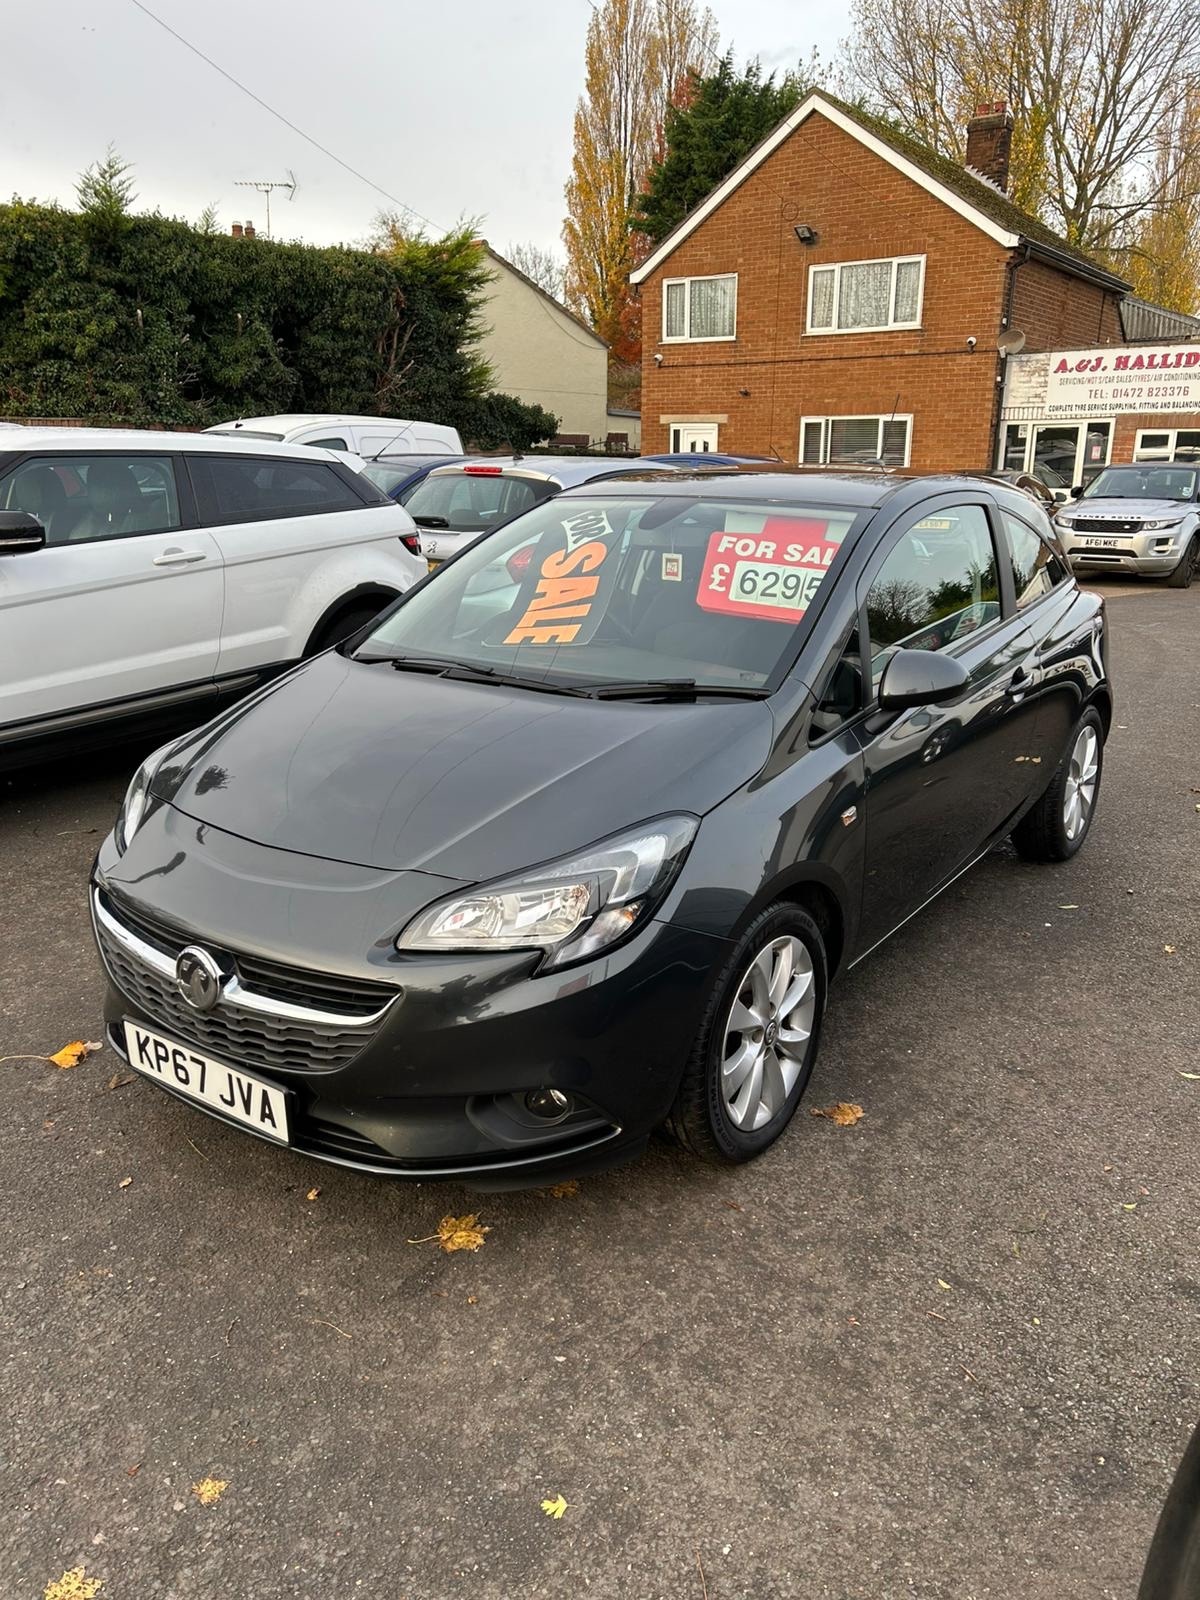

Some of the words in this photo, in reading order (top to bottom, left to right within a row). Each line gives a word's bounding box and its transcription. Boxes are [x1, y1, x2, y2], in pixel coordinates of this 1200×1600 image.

[1113, 352, 1200, 370] HALLID
[1048, 404, 1073, 412] COMPLETE
[1088, 403, 1108, 411] SERVICE
[1139, 401, 1159, 410] FITTING
[1160, 401, 1171, 409] AND
[1089, 389, 1108, 399] TEL:
[1112, 387, 1143, 399] 01472
[1147, 386, 1190, 397] 823376
[566, 510, 606, 544] FOR
[717, 535, 777, 559] FOR
[783, 543, 838, 567] SAL
[1085, 538, 1102, 546] AF61
[1103, 539, 1119, 547] MKE
[708, 563, 731, 592] £
[503, 541, 608, 645] SALE
[135, 1030, 206, 1094] KP67
[219, 1072, 277, 1129] JVA
